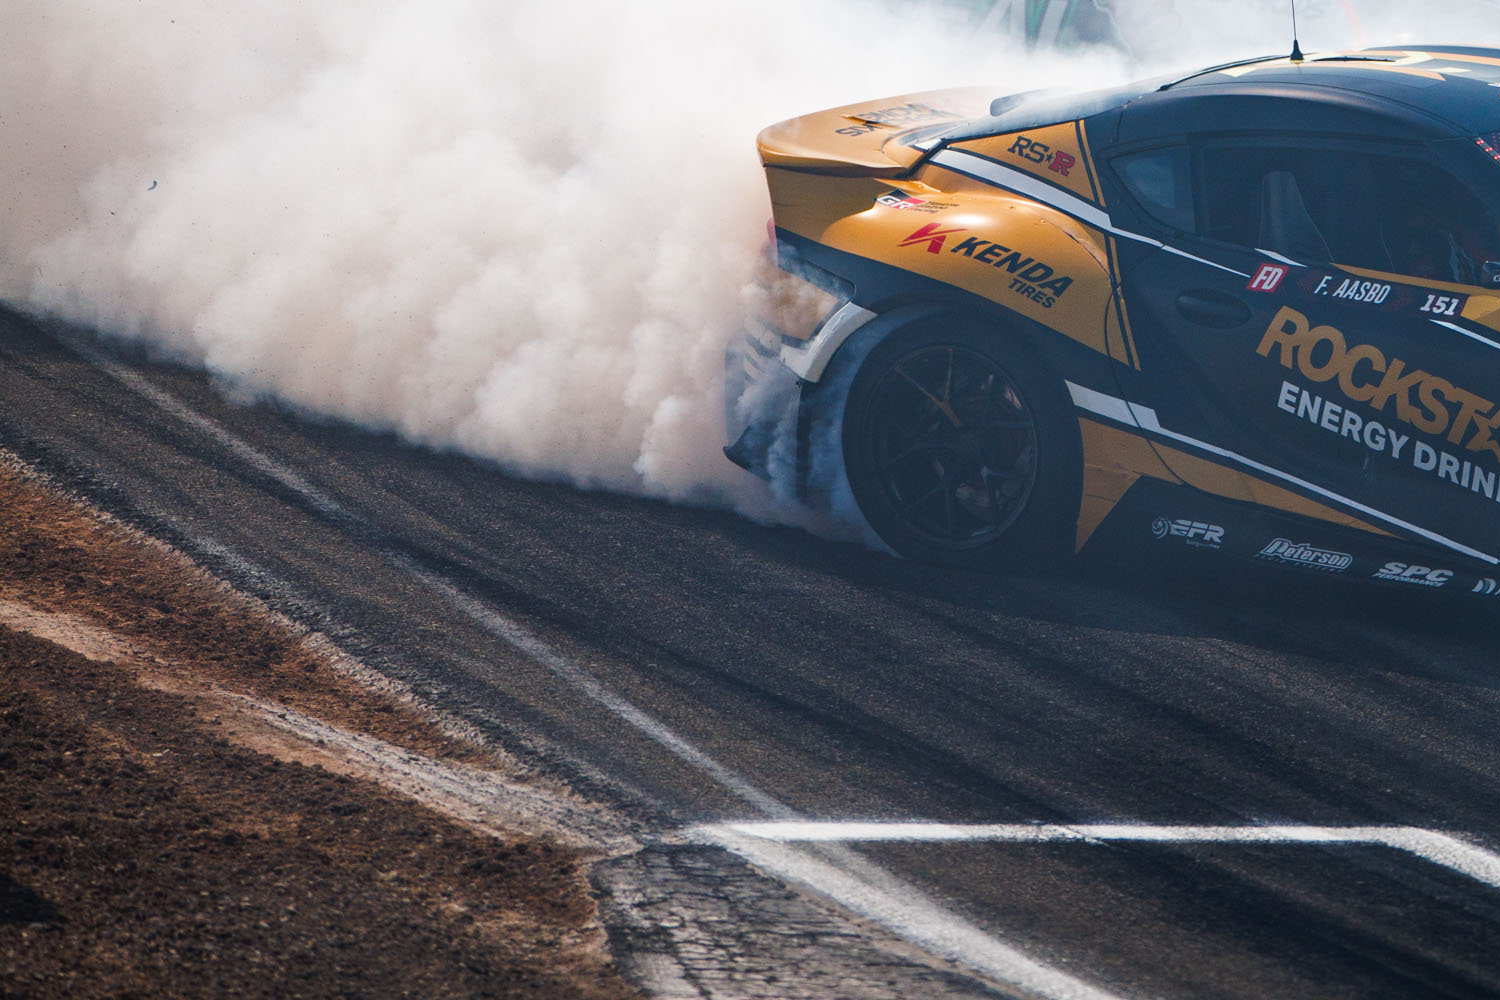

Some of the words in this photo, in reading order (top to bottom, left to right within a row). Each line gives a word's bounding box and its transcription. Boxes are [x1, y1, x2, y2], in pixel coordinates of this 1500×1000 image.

[877, 195, 914, 209] GR
[951, 236, 1075, 298] KENDA
[1252, 266, 1283, 290] FD
[1008, 278, 1056, 309] TIRES
[1314, 275, 1332, 295] F.
[1333, 279, 1391, 304] AASBO
[1420, 294, 1459, 315] 151
[1277, 381, 1411, 459] ENERGY
[1265, 539, 1350, 568] Peterson
[1379, 562, 1454, 581] SPC
